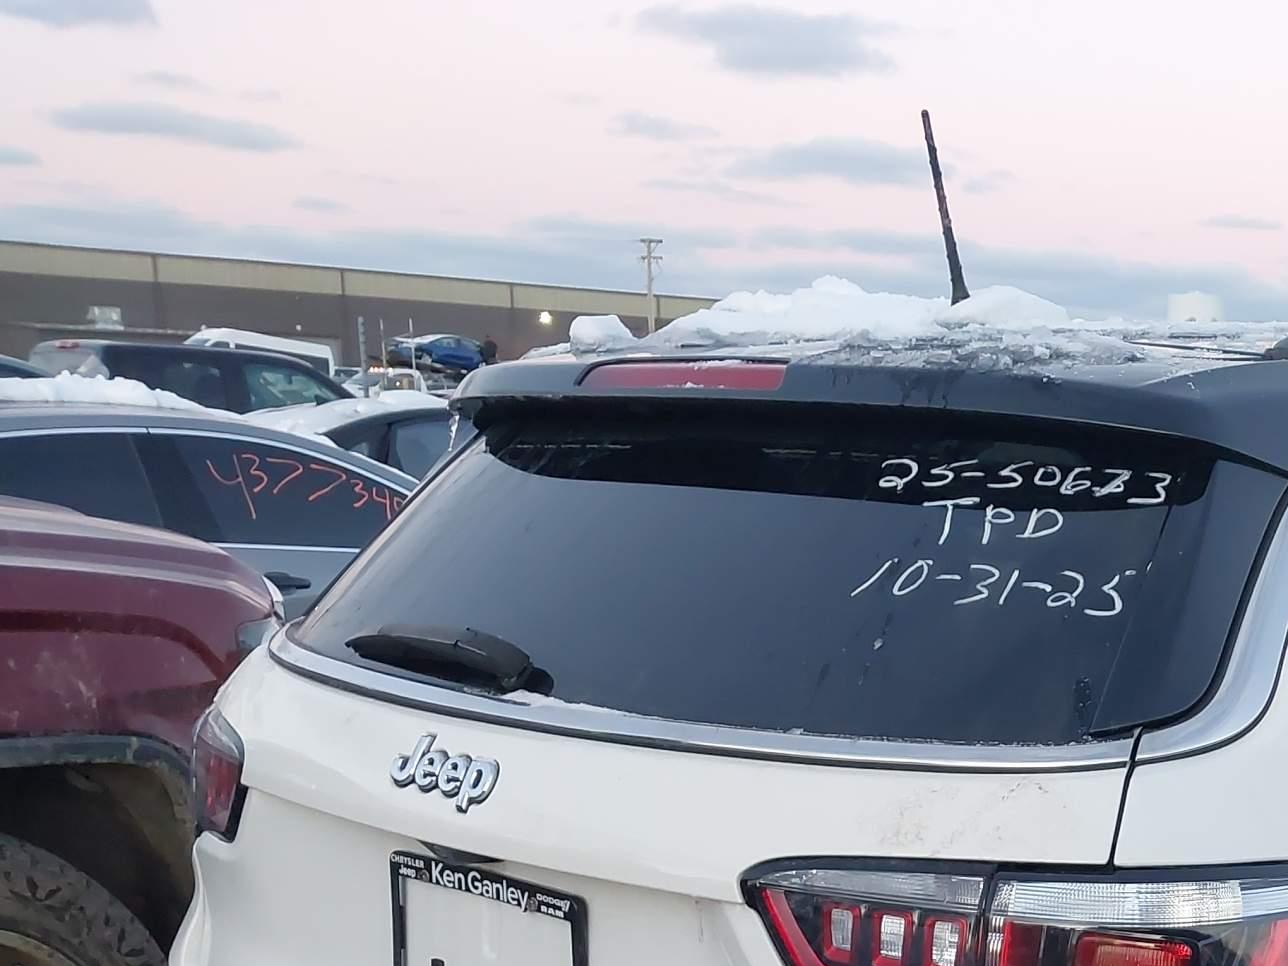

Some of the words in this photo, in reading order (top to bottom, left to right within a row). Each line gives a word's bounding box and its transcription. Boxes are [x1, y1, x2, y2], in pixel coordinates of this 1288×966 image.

[922, 497, 1064, 545] TPD
[851, 558, 1137, 616] 10-31-25
[390, 732, 501, 814] Jeep
[431, 861, 466, 891] Ken
[467, 870, 528, 913] Ganley
